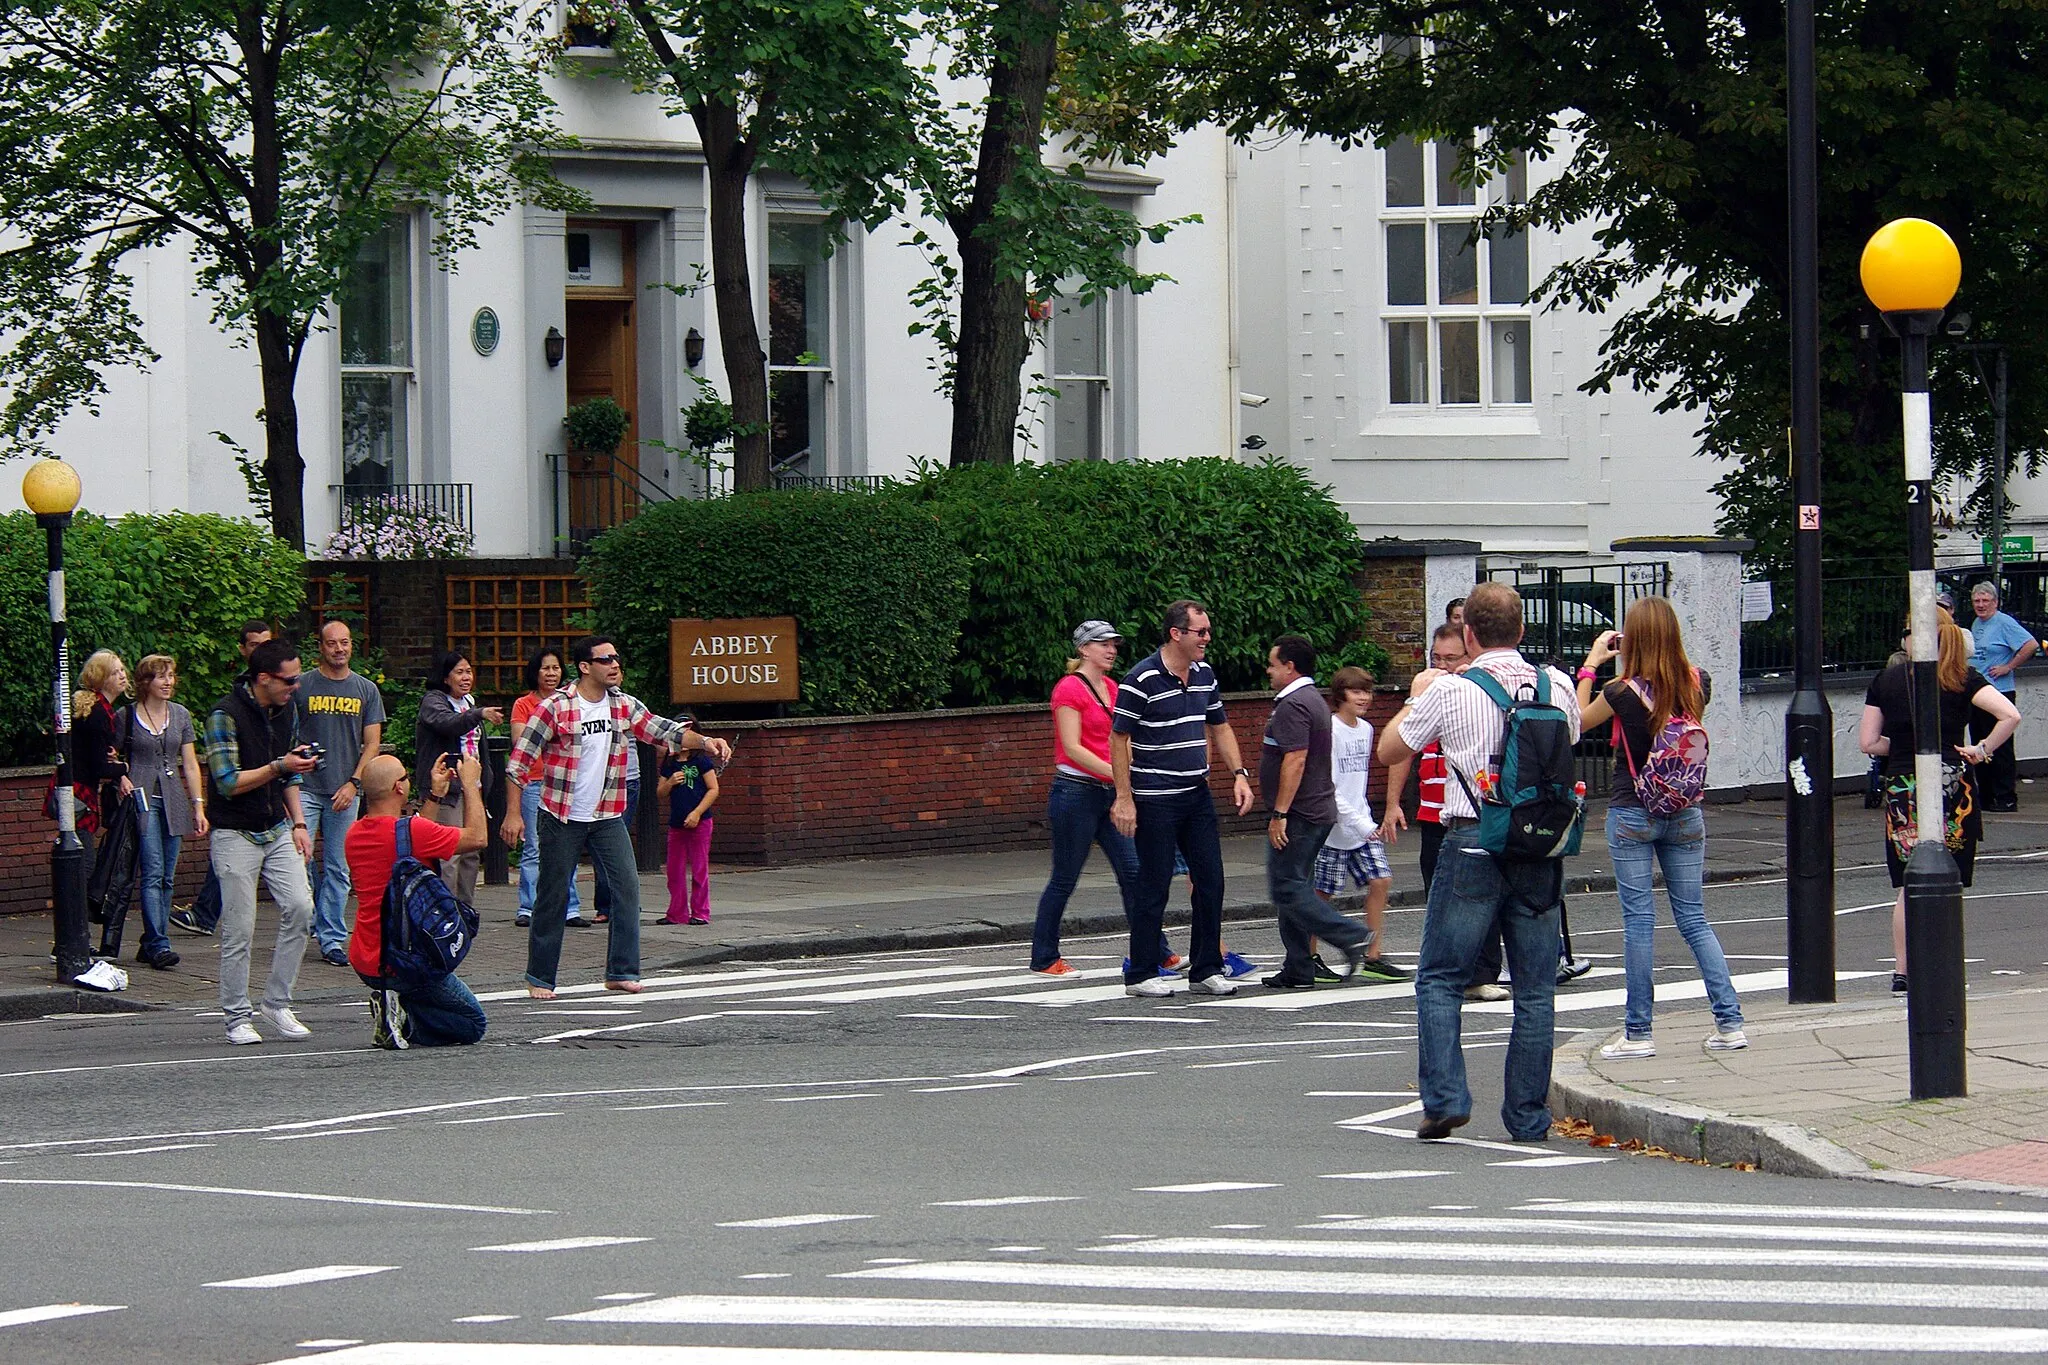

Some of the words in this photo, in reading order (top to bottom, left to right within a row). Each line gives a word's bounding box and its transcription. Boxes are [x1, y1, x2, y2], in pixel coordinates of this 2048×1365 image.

[1907, 484, 1919, 504] 2
[2005, 541, 2021, 549] Fire
[690, 635, 778, 656] ABBEY
[691, 664, 779, 685] HOUSE
